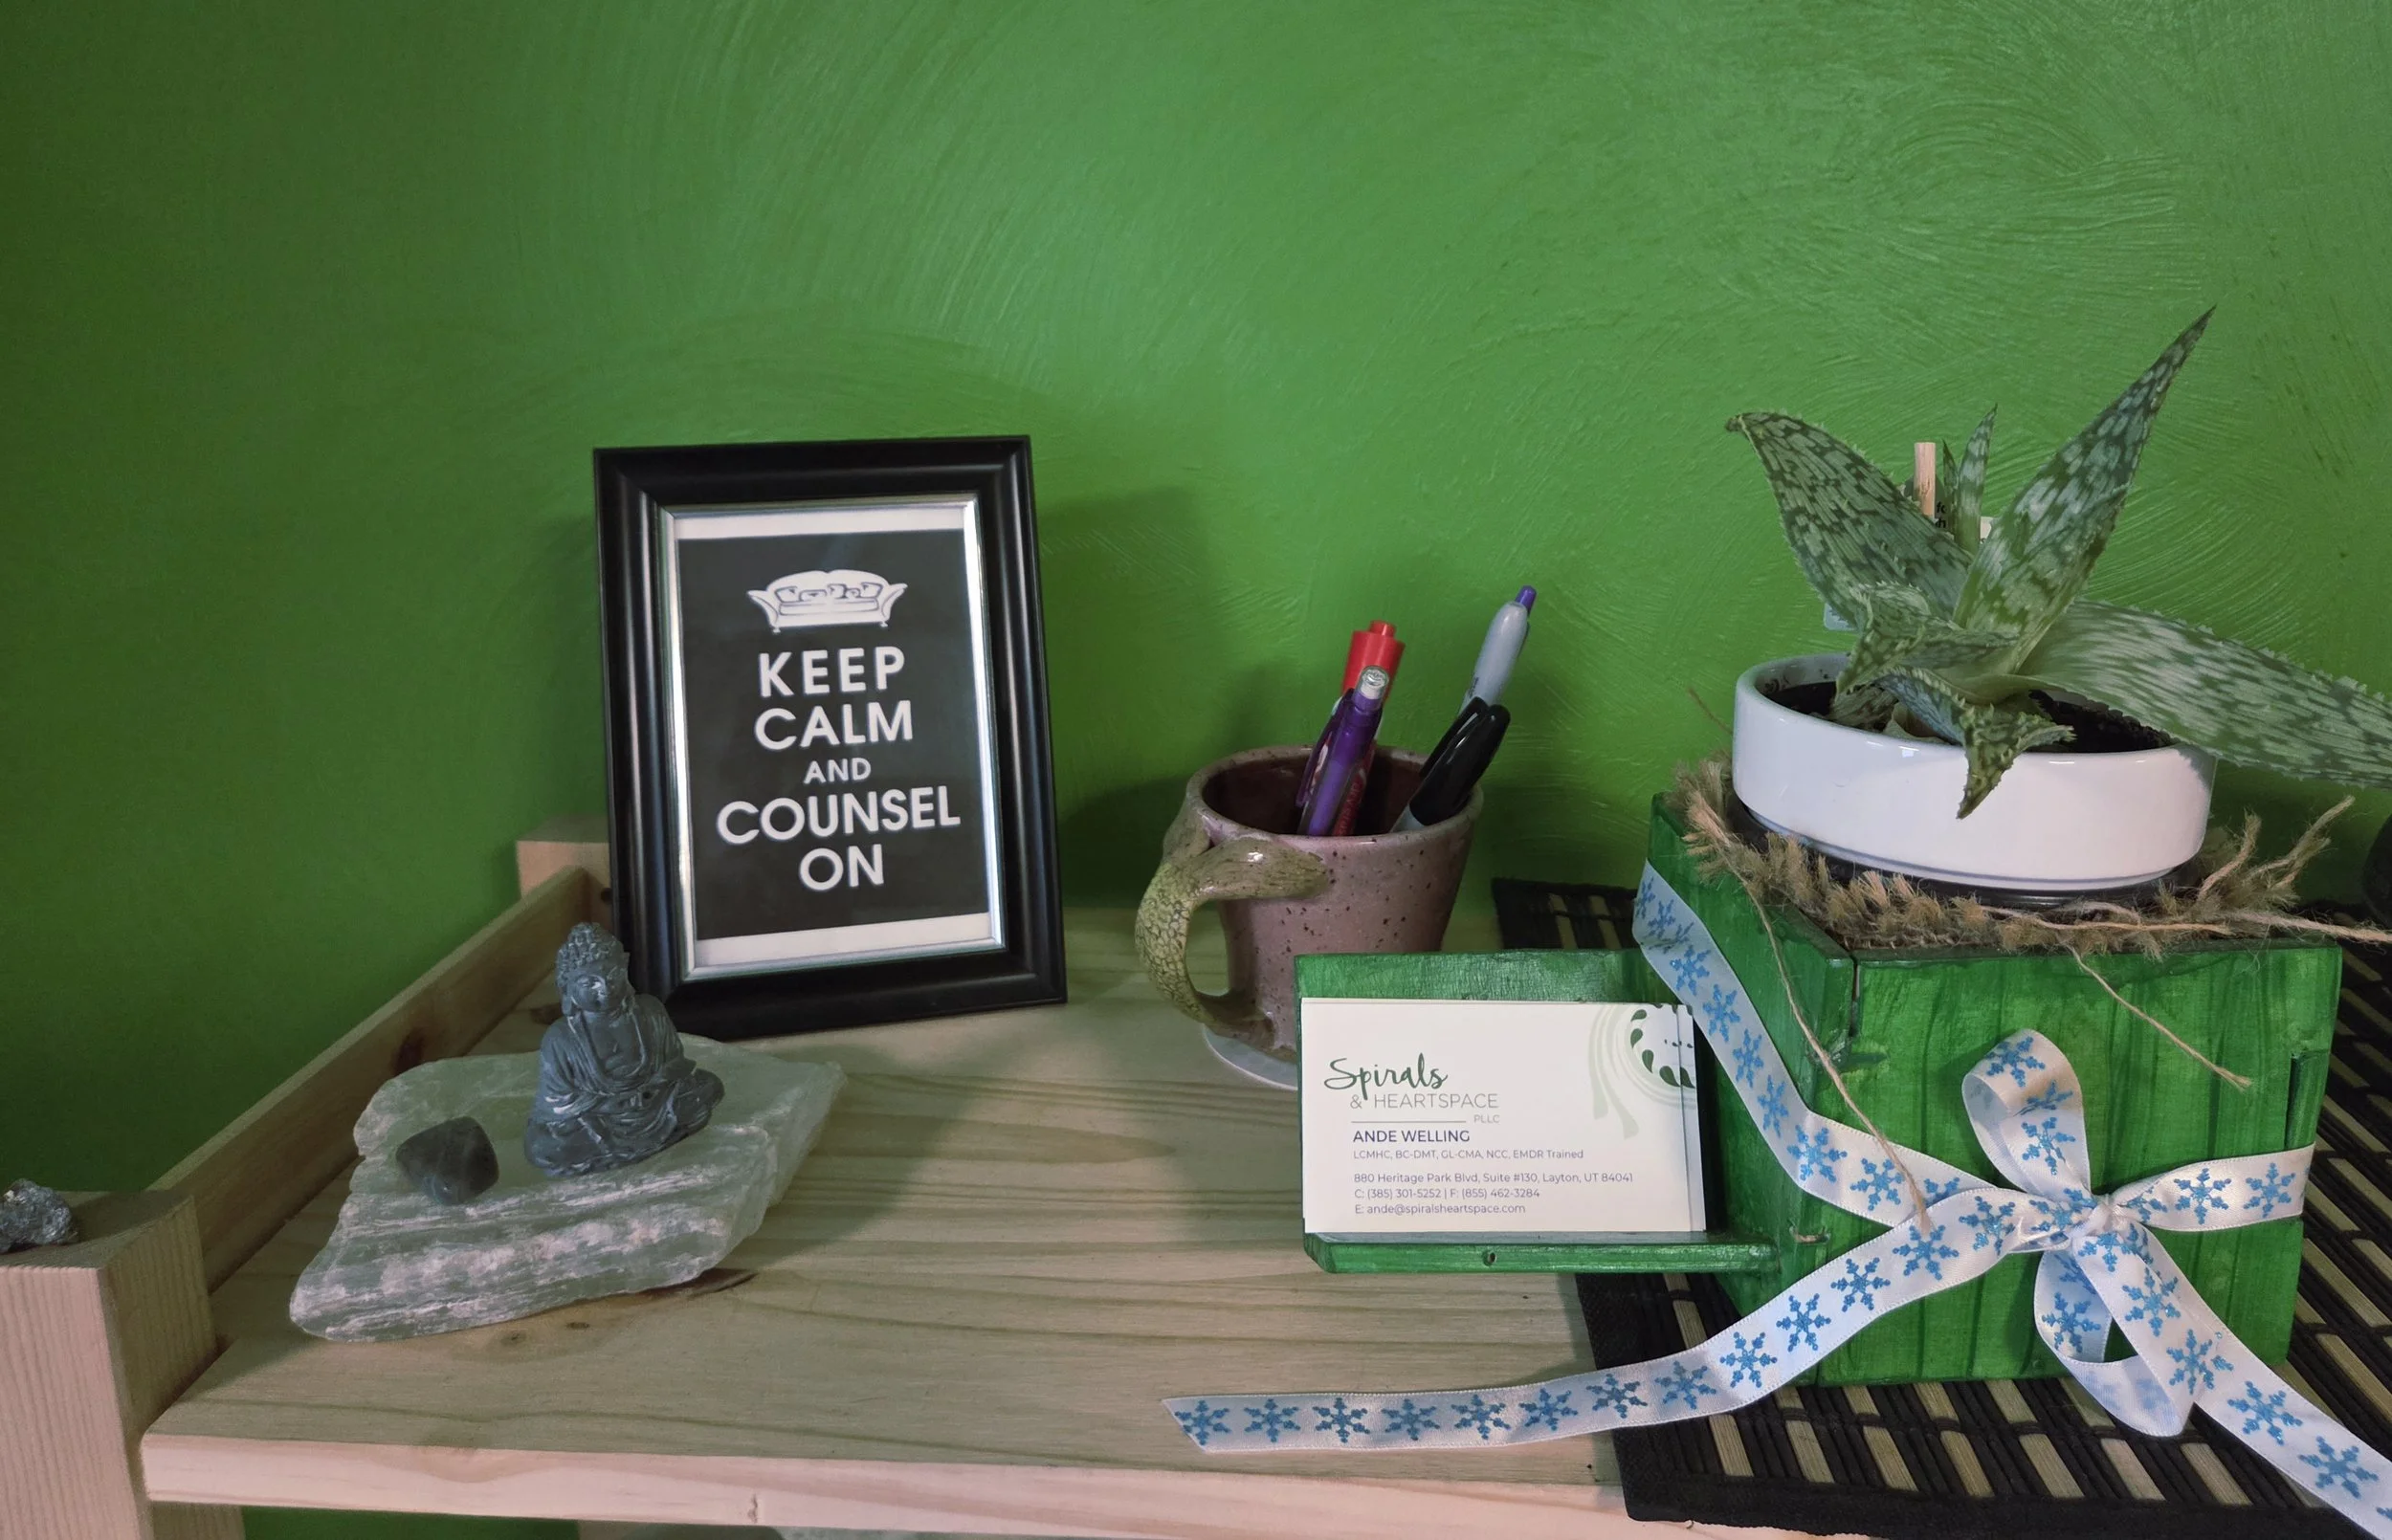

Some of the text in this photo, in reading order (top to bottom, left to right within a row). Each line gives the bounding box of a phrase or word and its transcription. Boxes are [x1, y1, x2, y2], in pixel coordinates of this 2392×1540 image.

[759, 646, 906, 697] KEEP
[754, 699, 913, 751] CALM
[803, 757, 872, 784] AND
[717, 785, 961, 845] COUNSEL
[799, 844, 885, 891] ON
[1324, 1052, 1449, 1100] Spirals
[1350, 1093, 1499, 1109] & HEARTSPACE
[1473, 1113, 1500, 1123] PLLC
[1353, 1129, 1471, 1143] ANDE WELLING
[1353, 1150, 1393, 1160] LCMHC,
[1395, 1150, 1439, 1160] BC-DMT,
[1486, 1149, 1511, 1159] NCC,
[1513, 1149, 1543, 1158] EMDR
[1546, 1149, 1584, 1159] Trained
[1354, 1173, 1633, 1185] 880 Heritage Park Blvd, Suite #130, Layton, UT 84041
[1354, 1189, 1364, 1199] C:
[1367, 1188, 1393, 1200] (385)
[1396, 1189, 1441, 1199] 301-5252
[1450, 1189, 1459, 1199] F:
[1462, 1188, 1488, 1199] (855)
[1491, 1188, 1540, 1199] 462-3284
[1355, 1203, 1526, 1216] E: ande@spiralsheartspace.com
